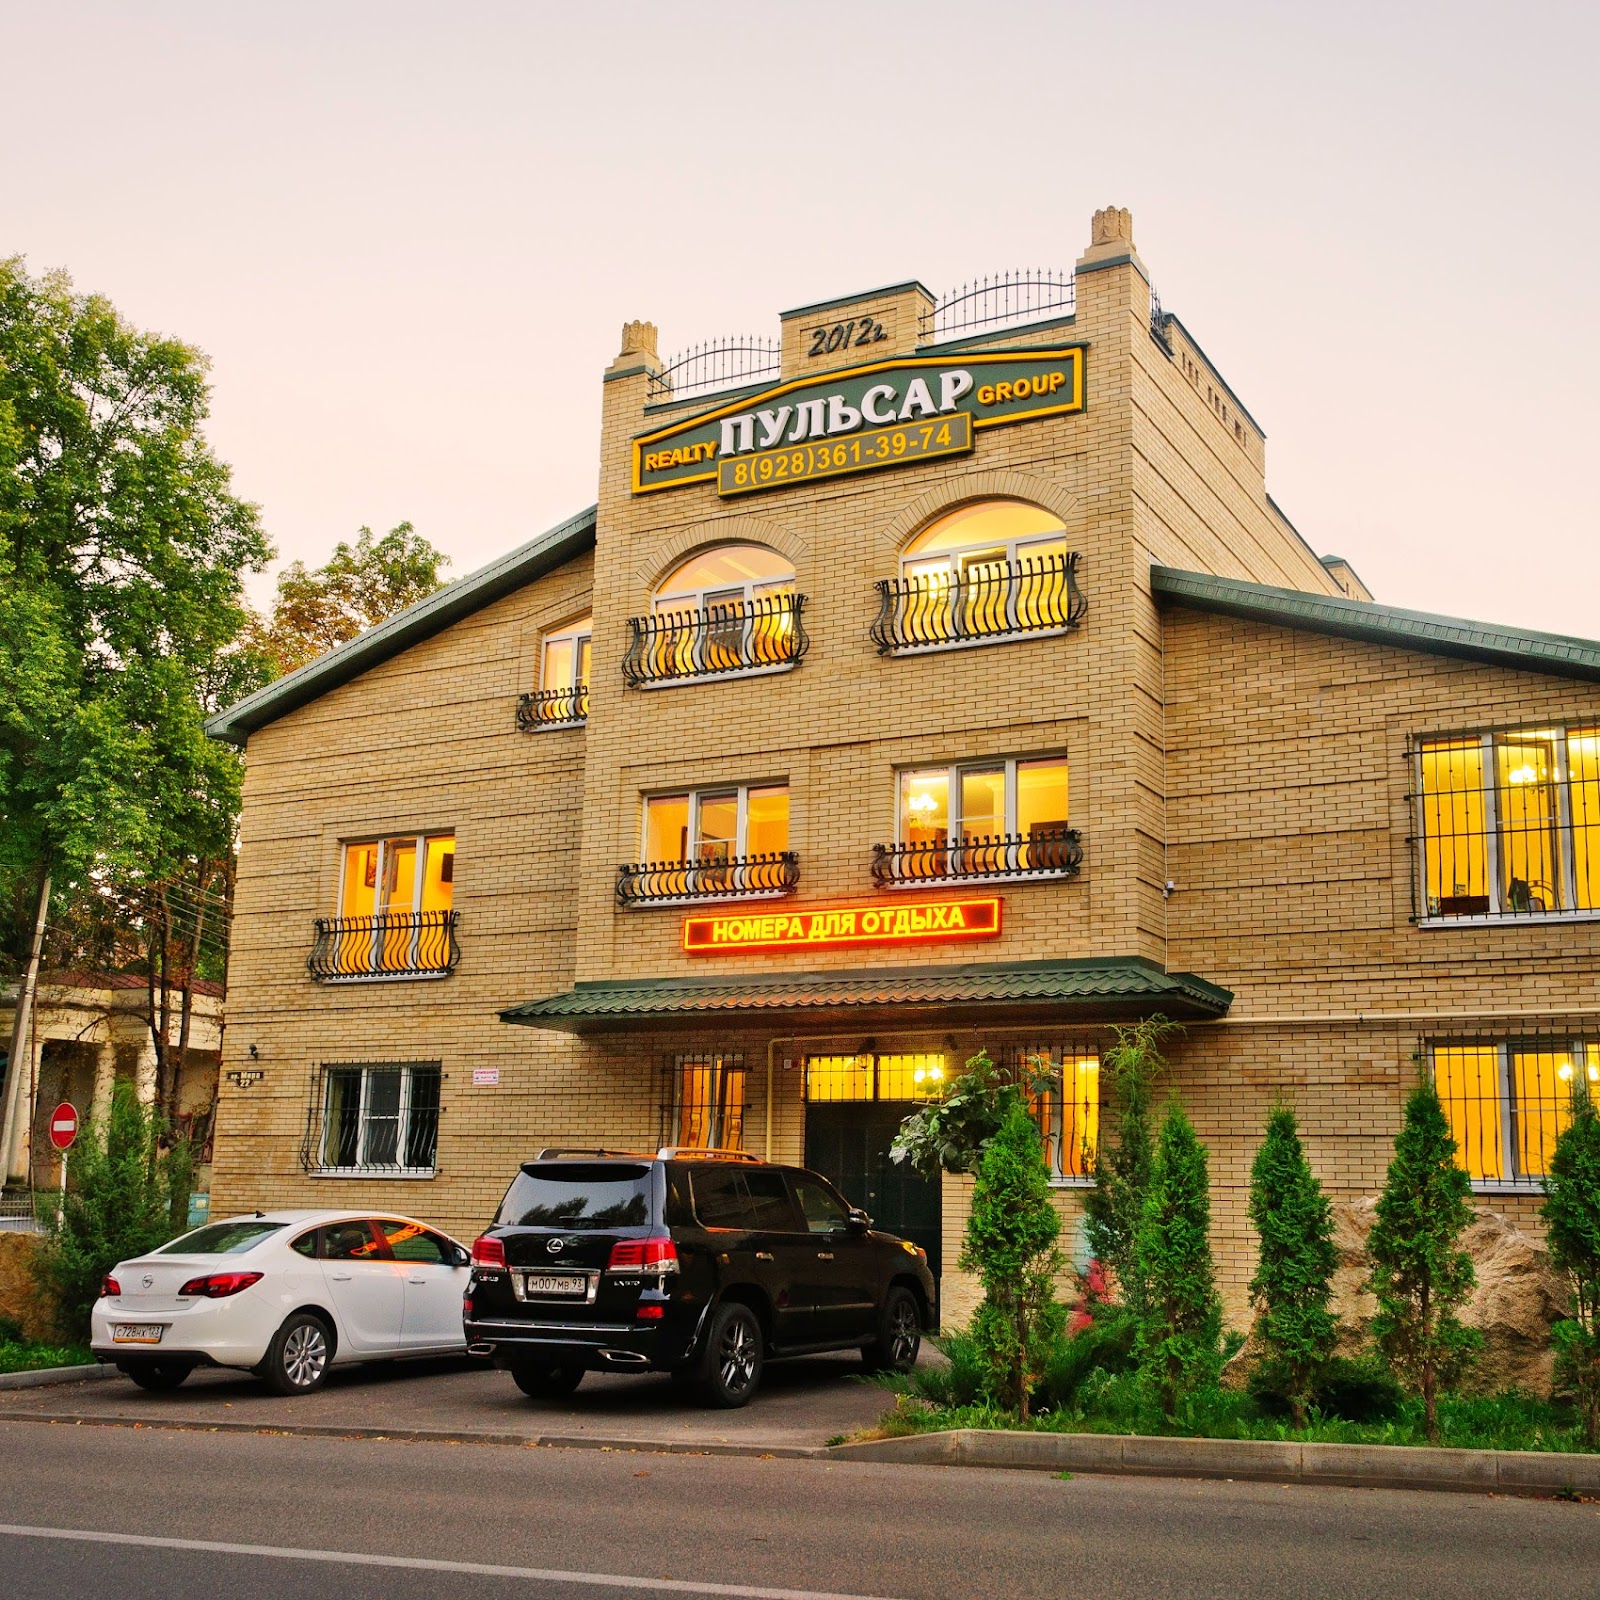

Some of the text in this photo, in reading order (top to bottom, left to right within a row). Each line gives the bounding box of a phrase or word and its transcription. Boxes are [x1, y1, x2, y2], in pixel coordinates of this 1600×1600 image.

[645, 369, 1066, 472] REALTY ПУЛЬСАР GROUP
[734, 423, 952, 485] 8(928)361-39-74
[712, 906, 965, 942] НОМЕРА ДЛЯ ОТДЫХА
[240, 1072, 261, 1081] Мира
[240, 1079, 251, 1087] 22
[572, 1278, 582, 1287] 93
[148, 1326, 160, 1336] 123
